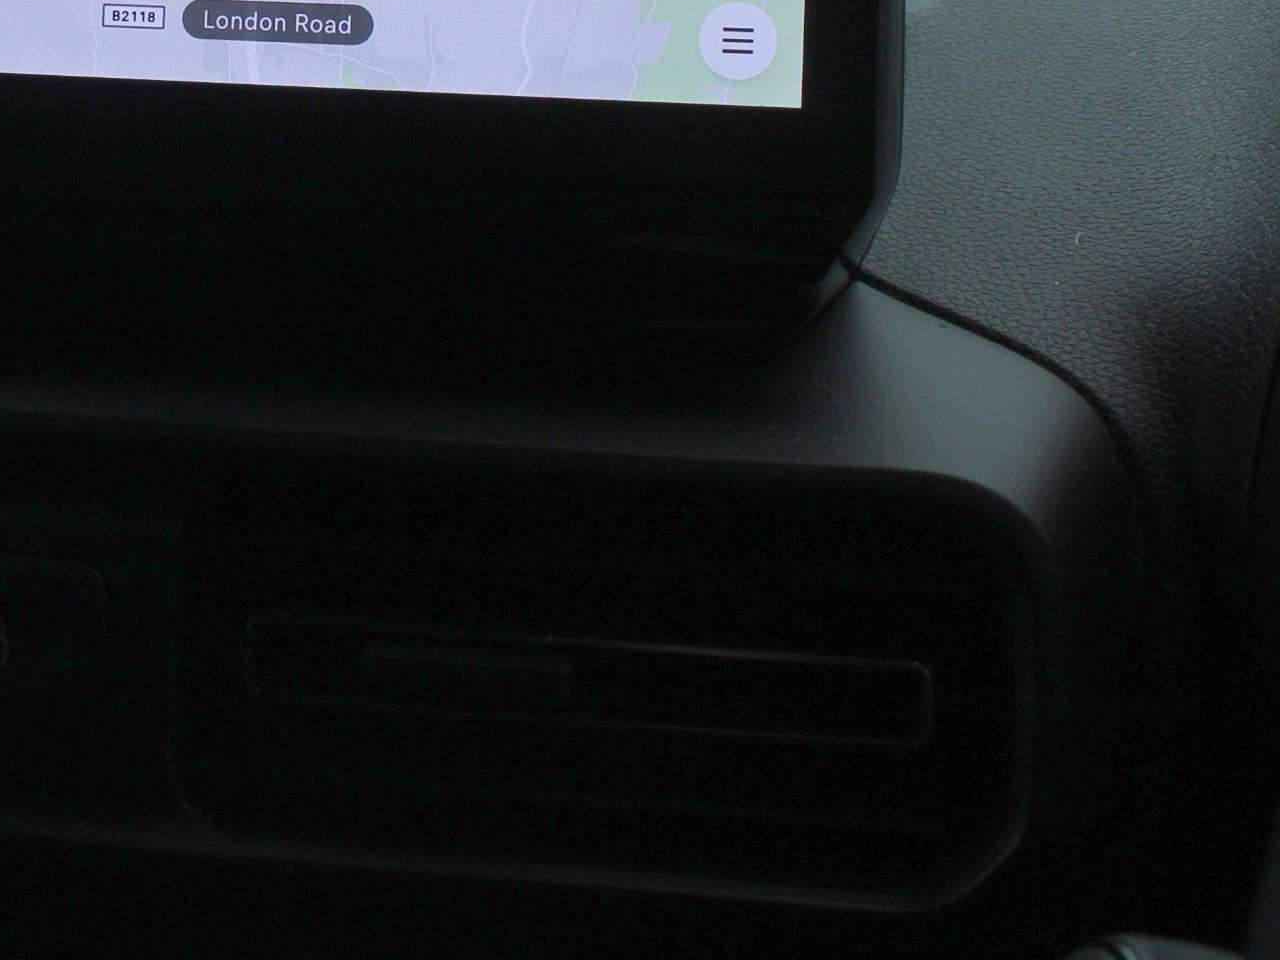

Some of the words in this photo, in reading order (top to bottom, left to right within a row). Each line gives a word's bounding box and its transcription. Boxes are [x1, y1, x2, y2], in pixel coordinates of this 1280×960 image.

[112, 10, 155, 23] B2118
[203, 10, 286, 32] London
[295, 14, 352, 35] Road
